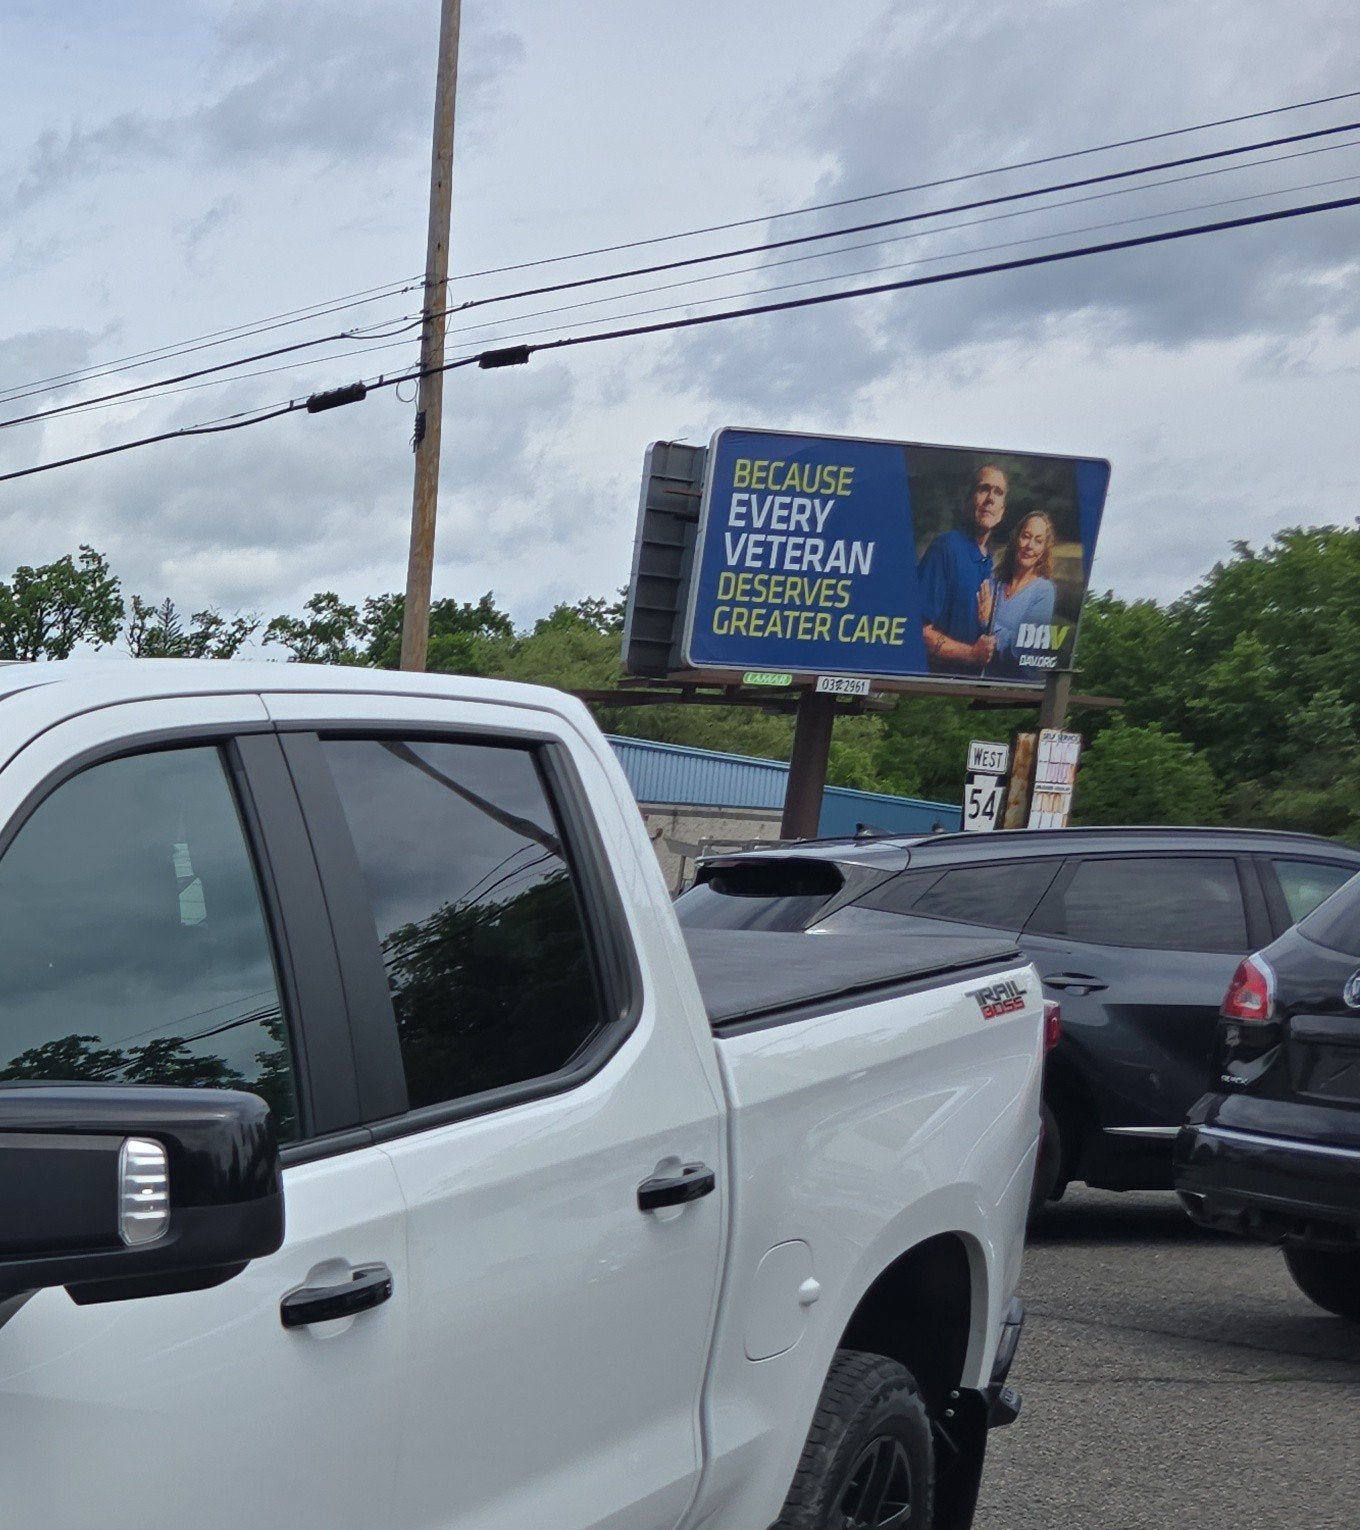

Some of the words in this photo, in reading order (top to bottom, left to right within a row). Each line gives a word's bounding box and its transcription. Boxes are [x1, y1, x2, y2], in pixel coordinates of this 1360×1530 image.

[733, 458, 855, 496] BECAUSE
[728, 492, 835, 533] EVERY
[724, 532, 876, 575] VETERAN
[717, 571, 853, 608] DESERVES
[712, 606, 831, 641] GREATER
[837, 613, 908, 646] CARE
[1015, 623, 1070, 651] DAV
[973, 747, 1003, 769] WEST
[968, 788, 997, 821] 54
[964, 980, 1028, 1007] TRAIL
[981, 996, 1026, 1021] BOSS
